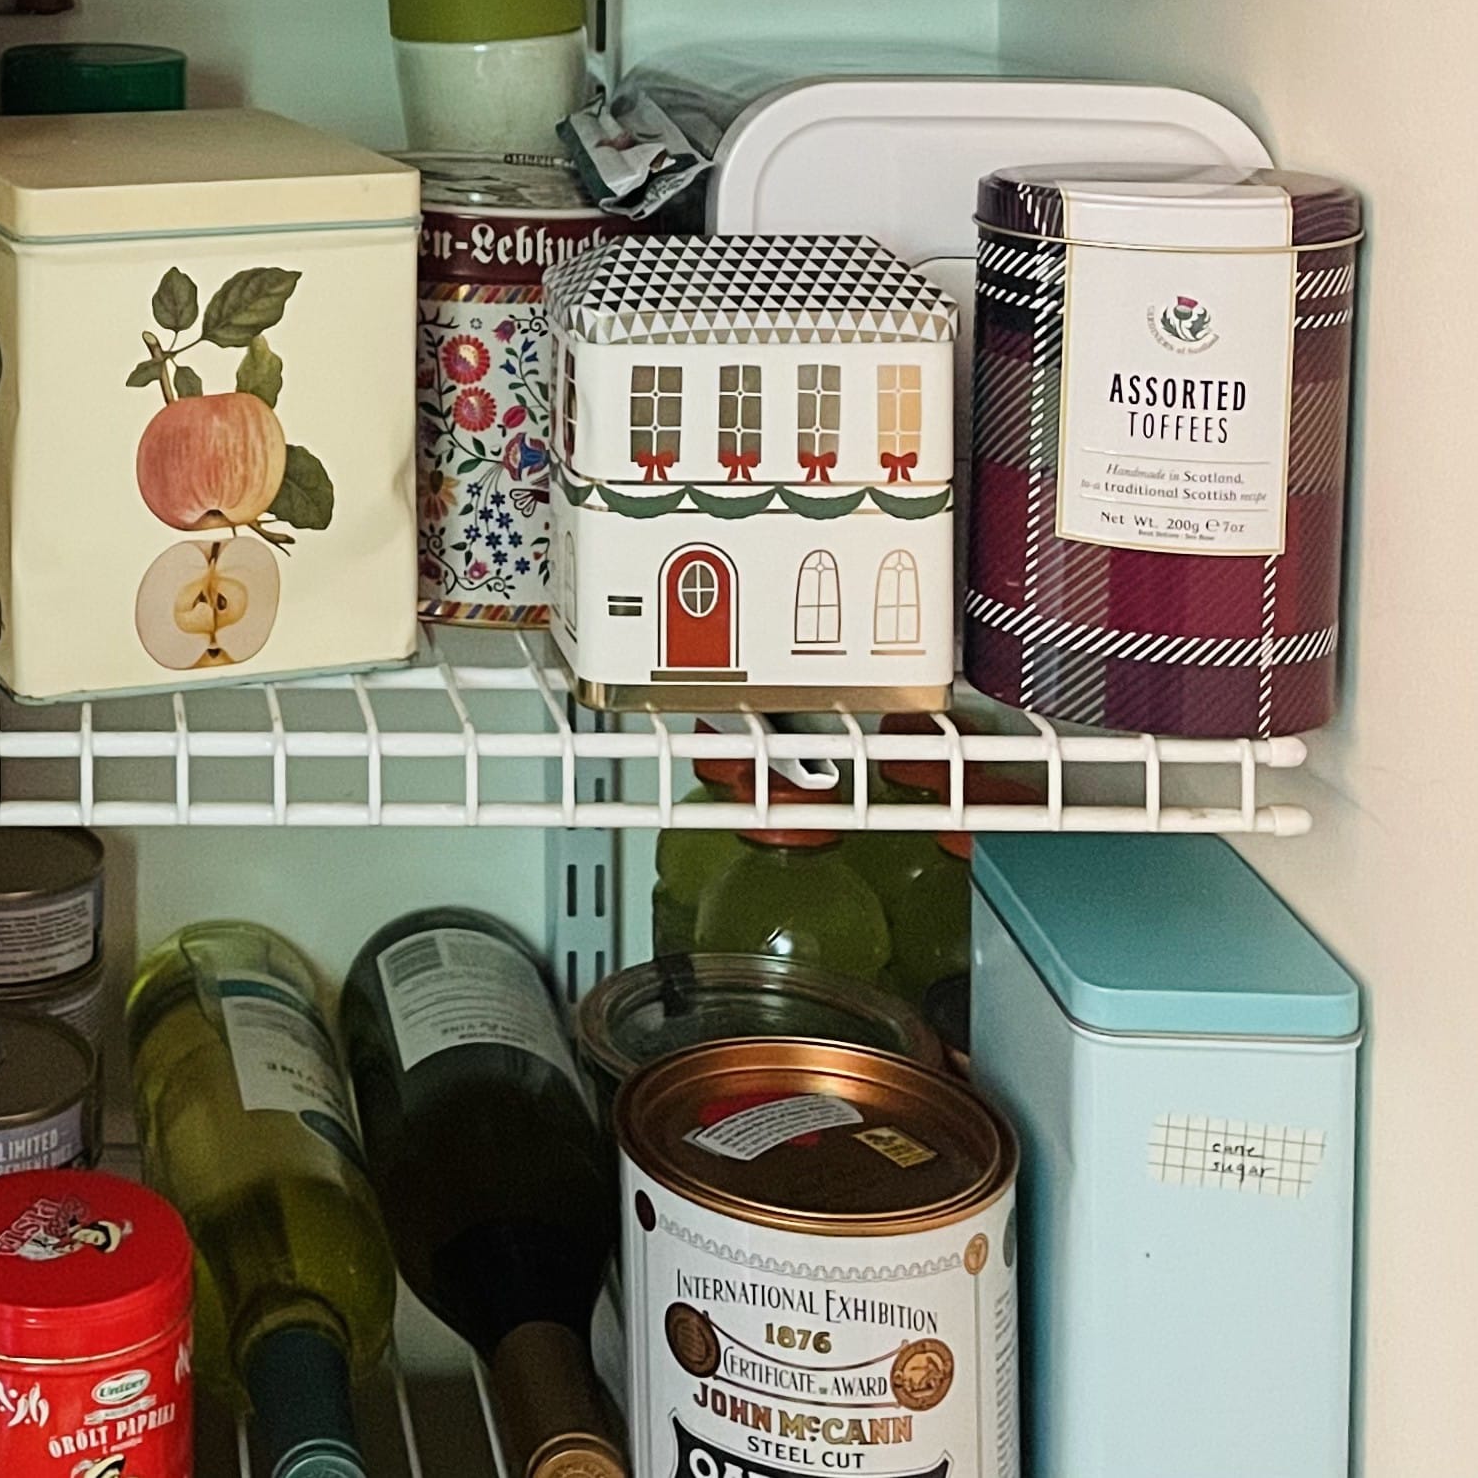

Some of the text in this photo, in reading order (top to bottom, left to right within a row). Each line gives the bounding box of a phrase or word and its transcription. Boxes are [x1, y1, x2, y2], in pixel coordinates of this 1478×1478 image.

[1109, 373, 1246, 411] ASSORTED
[1128, 411, 1228, 444] TOFFEES
[1106, 463, 1166, 480] Handmade
[1169, 471, 1179, 481] in
[1105, 481, 1267, 503] traditional Scottish recipe
[1100, 511, 1245, 533] Net Wt. 200g 7oz
[1212, 1143, 1264, 1159] cane
[1211, 1162, 1274, 1183] sugar
[677, 1269, 938, 1334] INTERNATIONAL EXHIBITION
[764, 1323, 832, 1354] 1876
[723, 1346, 887, 1397] CERTIFICATE AWARD
[99, 1378, 145, 1397] Univer
[693, 1381, 772, 1433] JOHN
[747, 1435, 865, 1469] STEEL CUT
